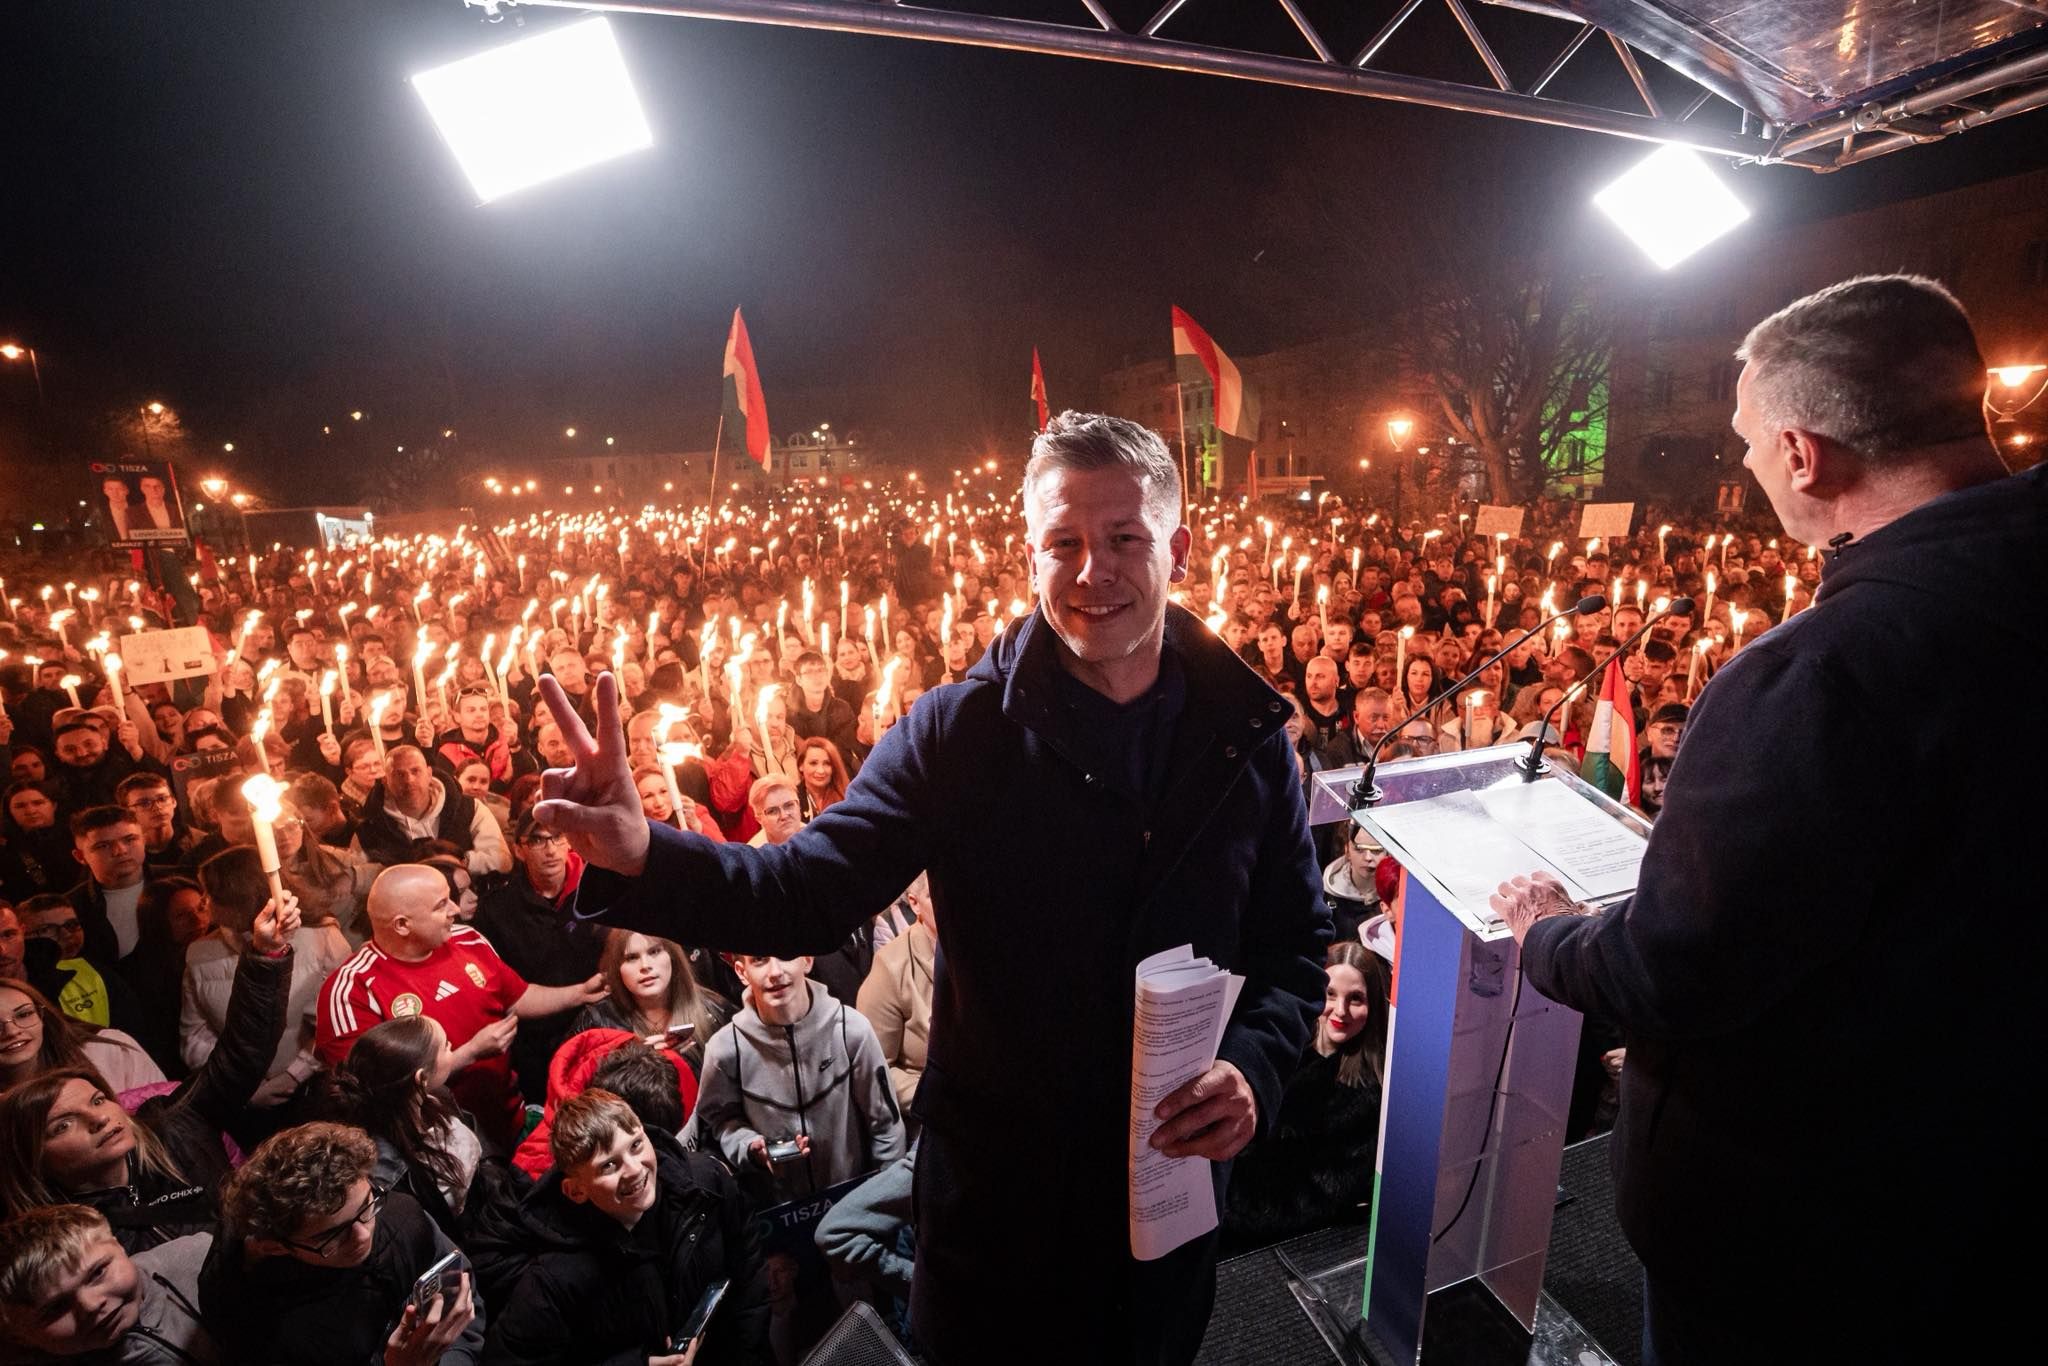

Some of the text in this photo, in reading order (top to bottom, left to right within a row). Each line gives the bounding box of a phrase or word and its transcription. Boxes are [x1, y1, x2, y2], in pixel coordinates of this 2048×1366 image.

[119, 464, 148, 473] TISZA
[207, 751, 239, 763] TISZA
[170, 1187, 193, 1200] CHIX
[780, 1199, 834, 1227] TISZA
